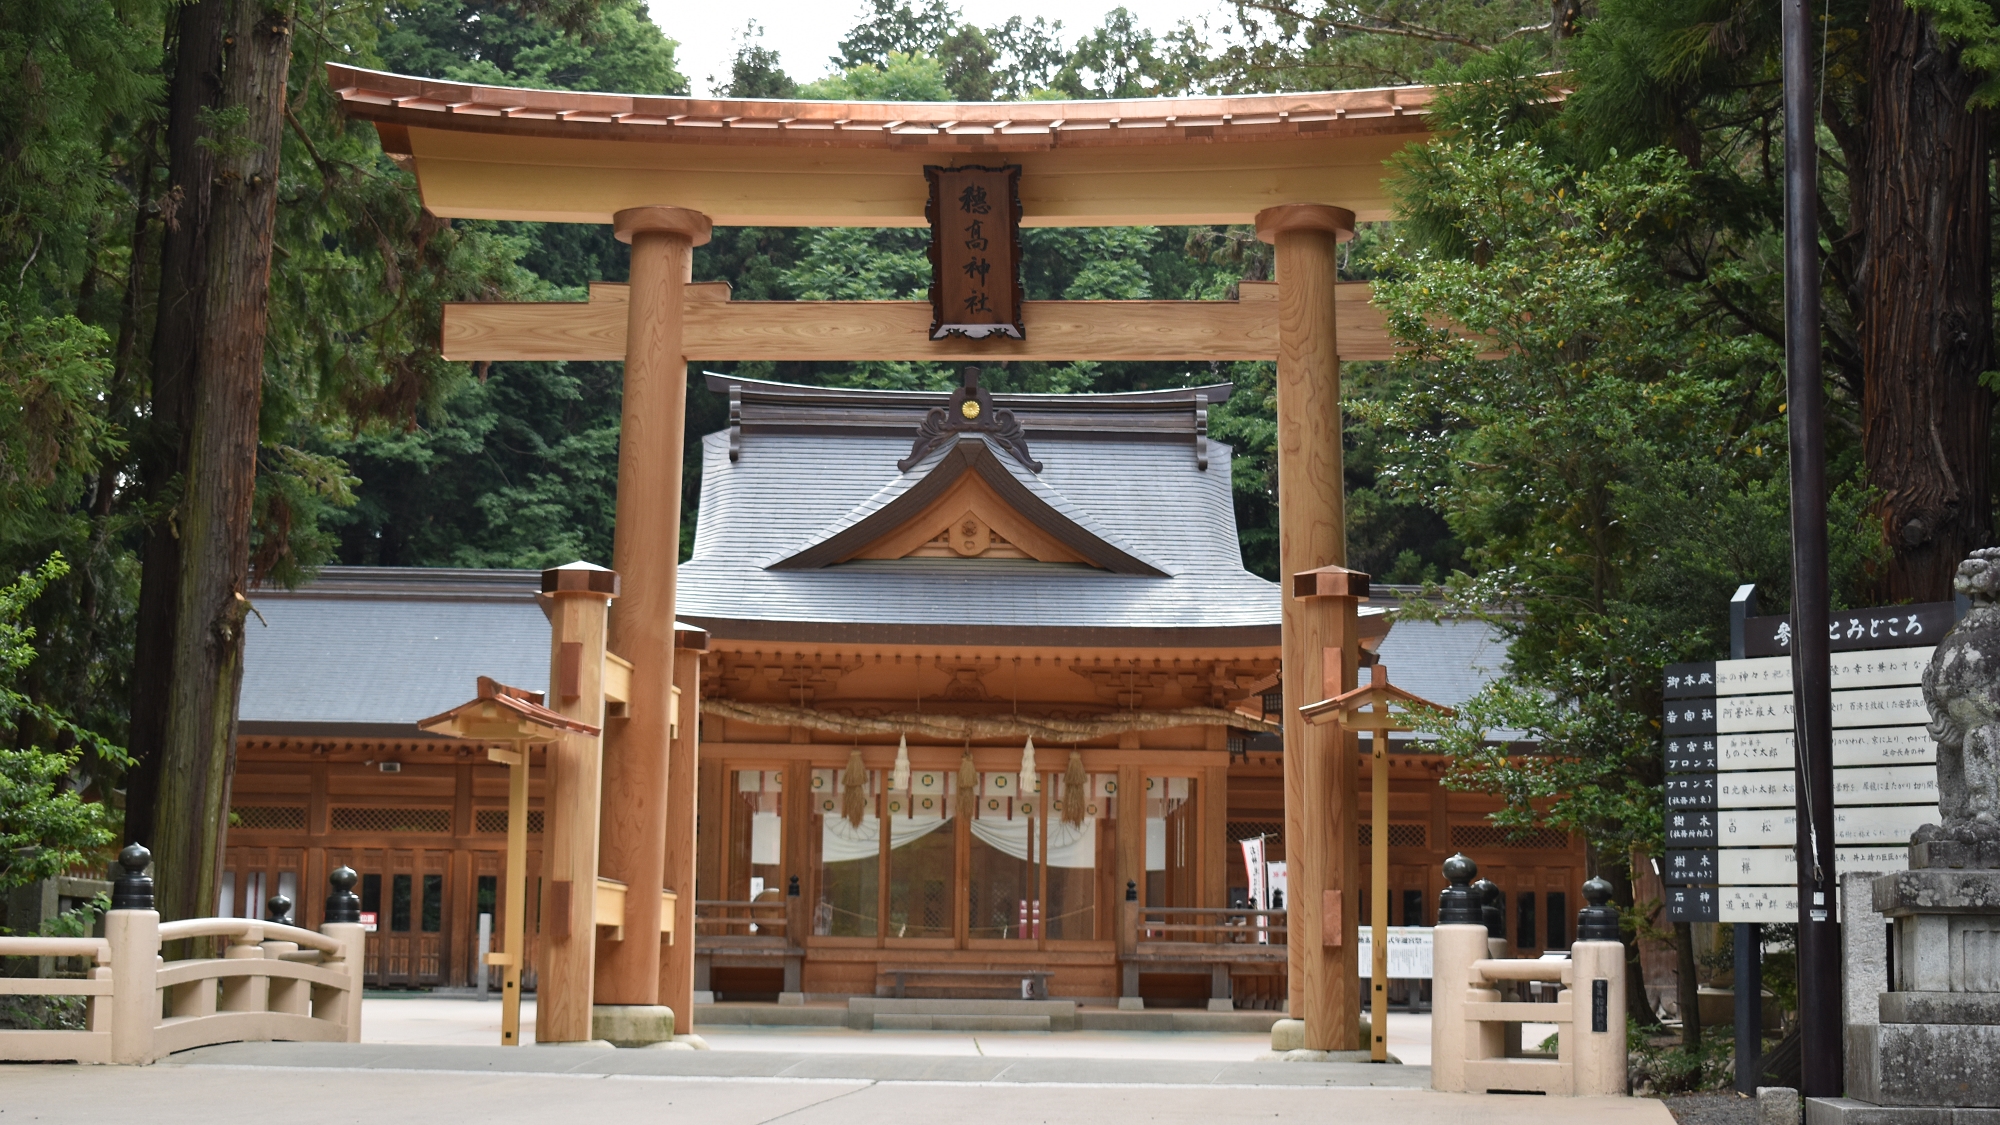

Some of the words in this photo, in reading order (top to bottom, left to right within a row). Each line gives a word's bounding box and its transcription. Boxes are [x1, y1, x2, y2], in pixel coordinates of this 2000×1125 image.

[1666, 672, 1713, 689] 御本殿
[1666, 708, 1713, 723] 若宮社
[1668, 741, 1714, 753] 若宮社
[1669, 758, 1715, 768] ブロンズ
[1667, 779, 1713, 789] ブロンズ
